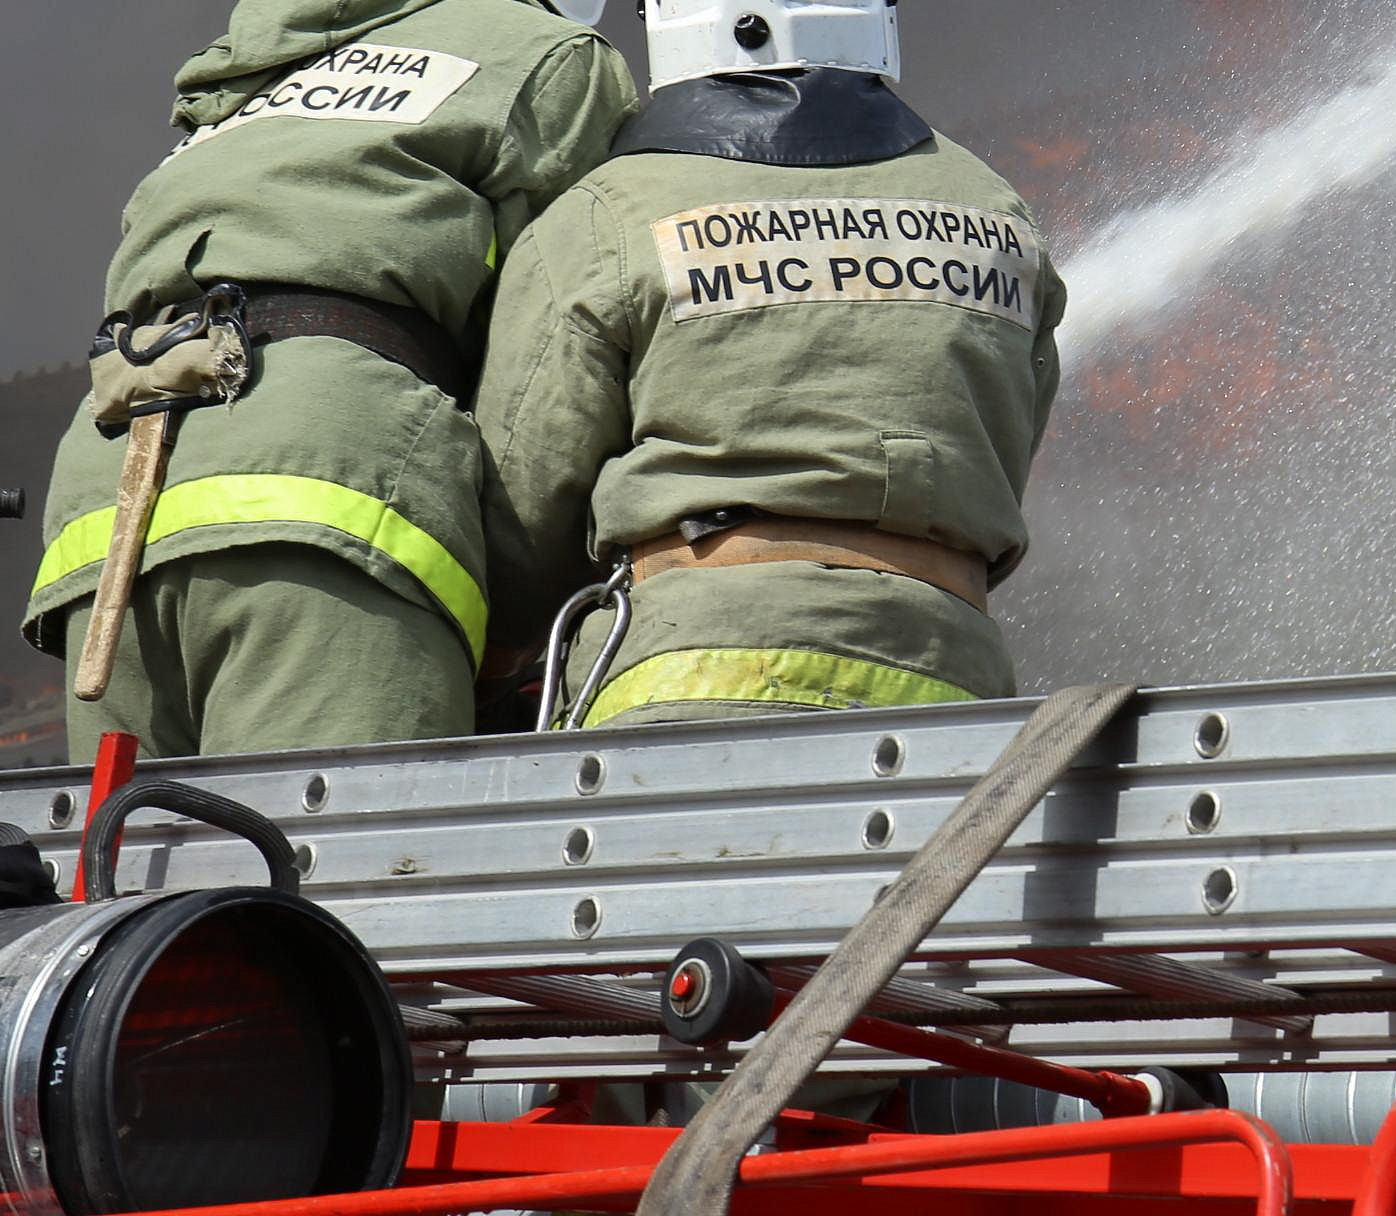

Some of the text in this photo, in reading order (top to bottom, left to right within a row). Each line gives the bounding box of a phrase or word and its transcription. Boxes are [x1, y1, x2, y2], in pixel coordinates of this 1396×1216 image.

[302, 48, 430, 78] ХРАНА
[214, 83, 411, 126] ОССИИ
[676, 208, 1023, 258] ПОЖАРНАЯ ОХРАНА
[688, 257, 1021, 313] МЧС РОССИИ
